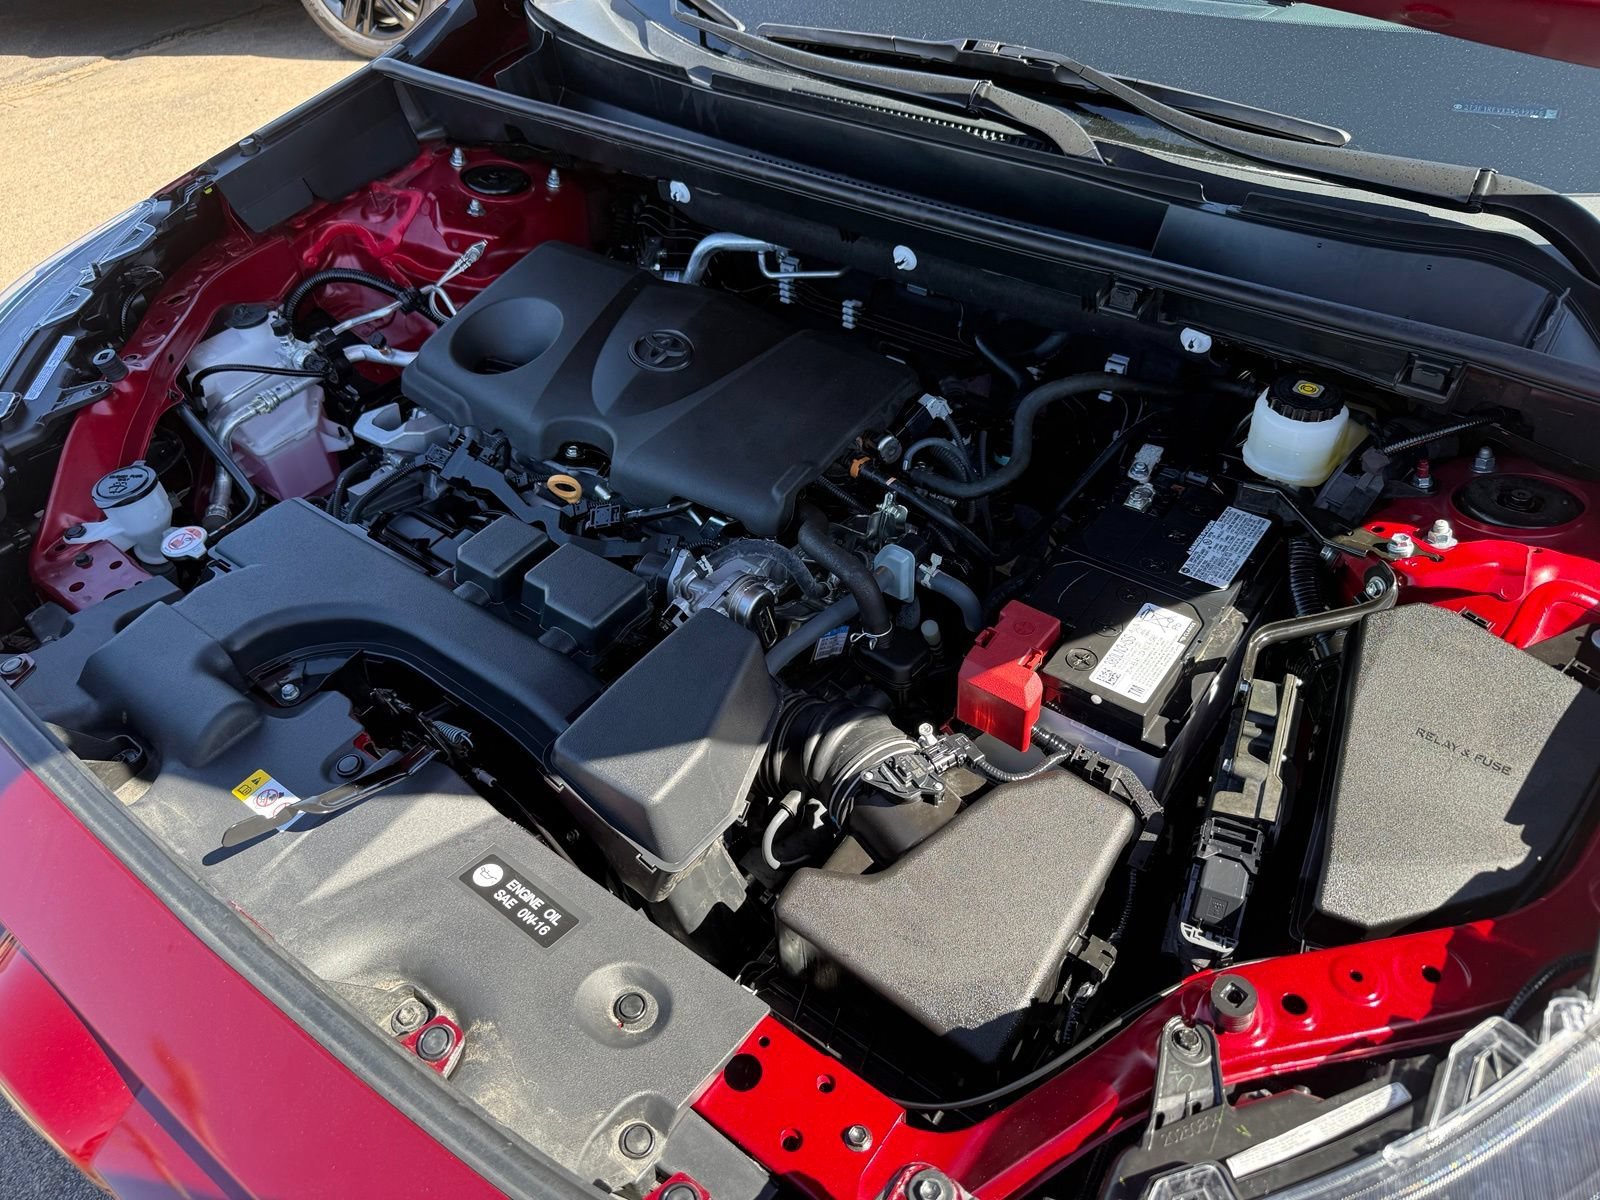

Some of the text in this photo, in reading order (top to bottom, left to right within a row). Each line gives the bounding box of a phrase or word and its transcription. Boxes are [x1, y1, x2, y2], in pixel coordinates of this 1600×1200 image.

[1415, 727, 1512, 775] RELAY & FUSE
[493, 889, 551, 936] SAE 0W-16
[505, 878, 563, 927] ENGINE OIL
